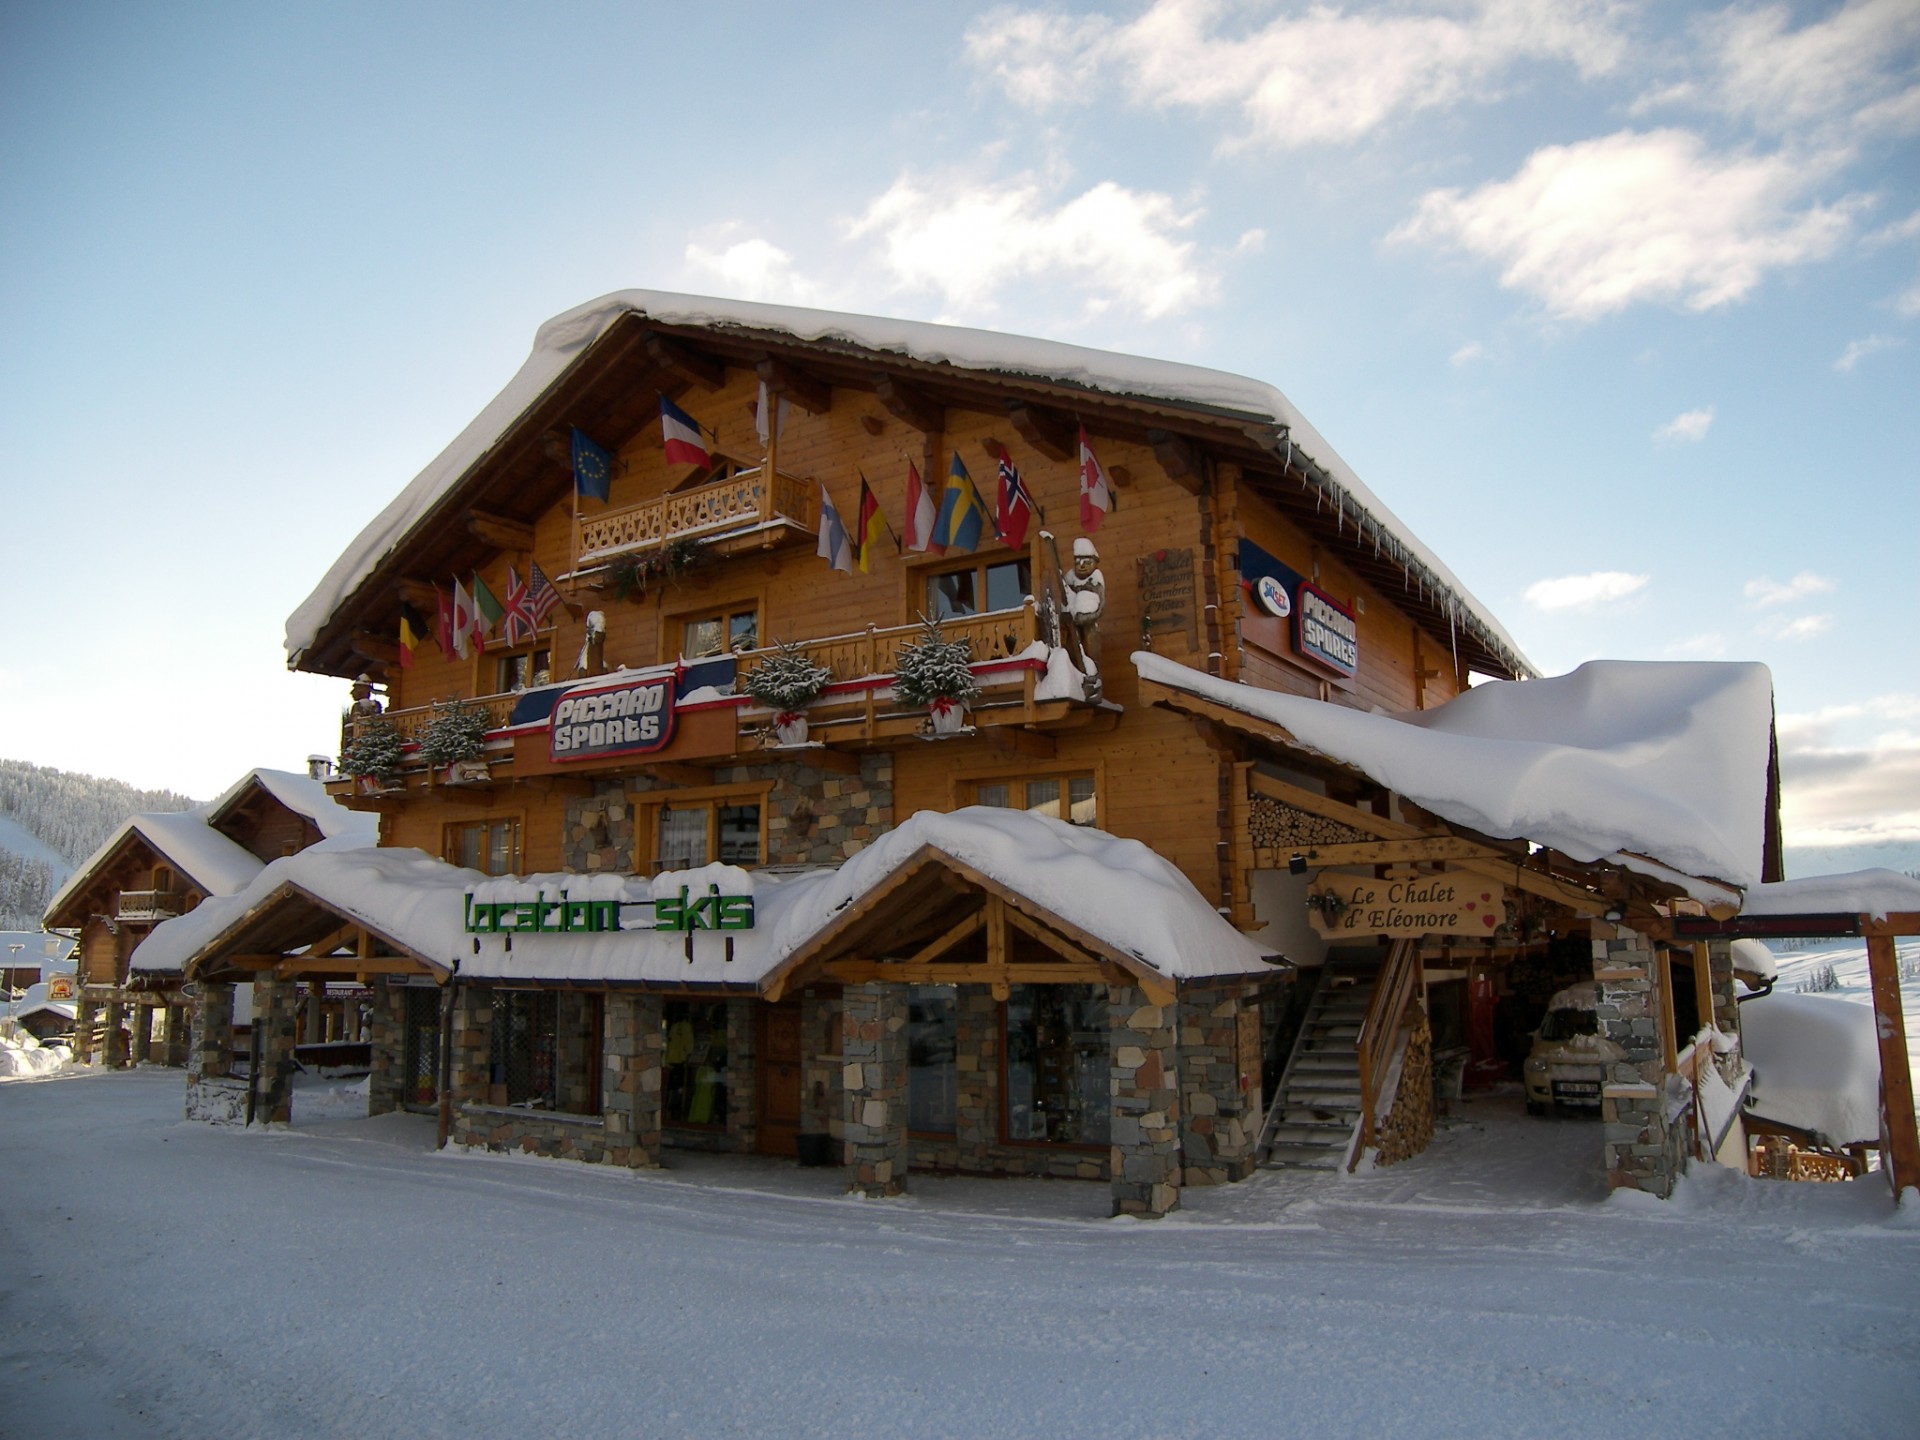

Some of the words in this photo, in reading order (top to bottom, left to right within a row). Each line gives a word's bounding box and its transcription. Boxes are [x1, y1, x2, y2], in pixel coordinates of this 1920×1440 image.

[656, 884, 755, 931] skis
[1350, 887, 1375, 905] Le
[1388, 882, 1456, 904] Chalet
